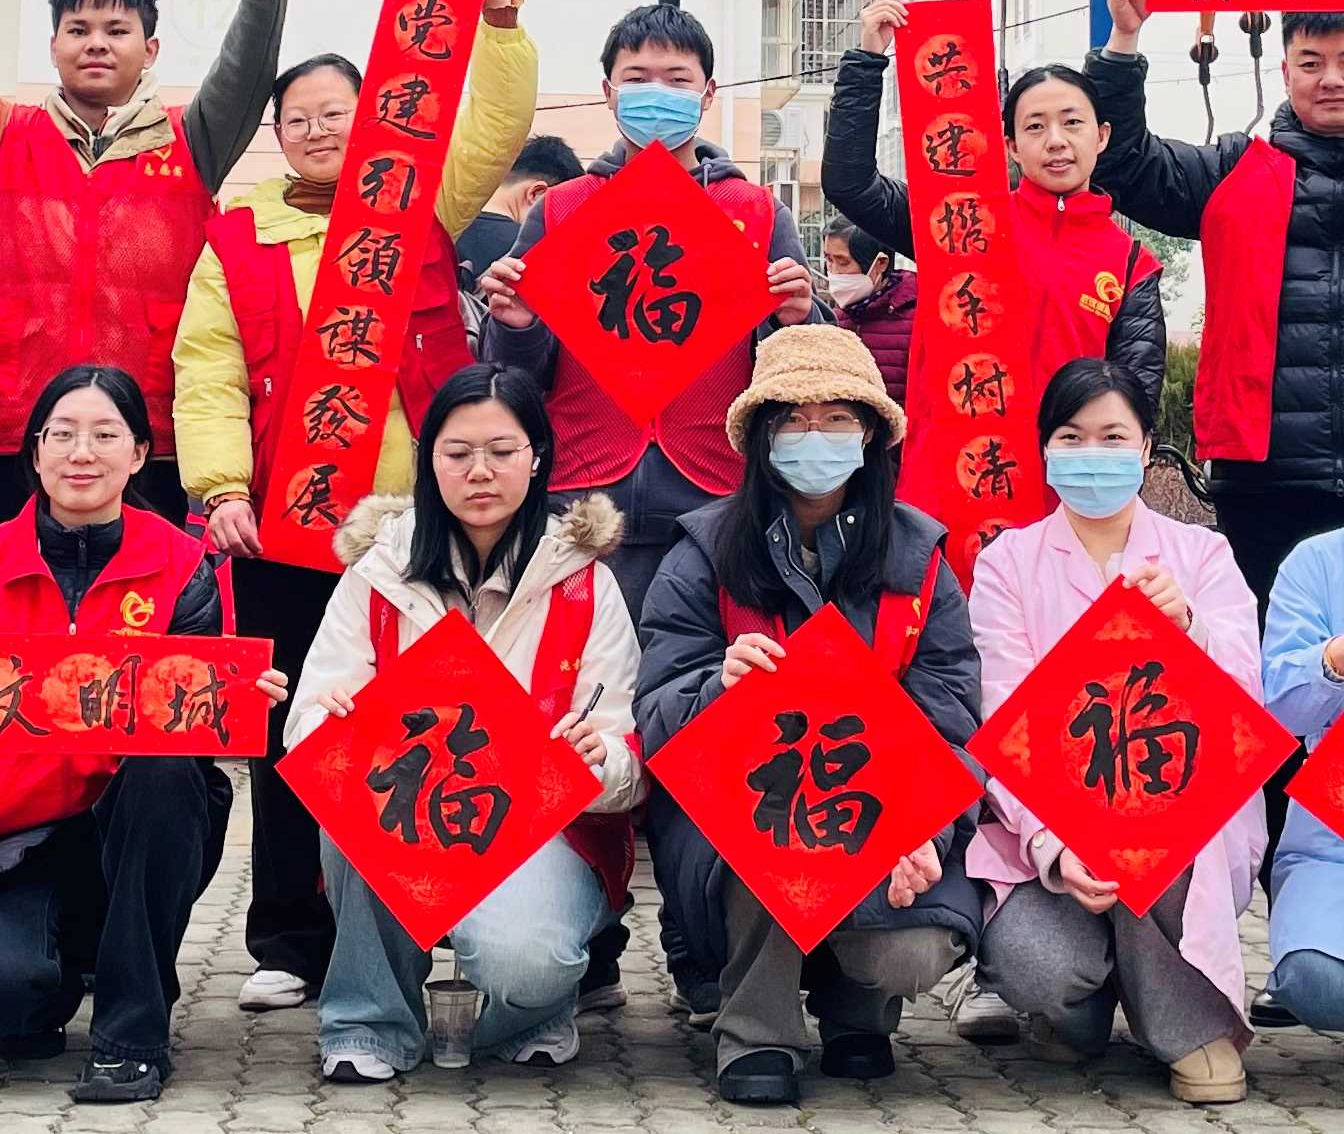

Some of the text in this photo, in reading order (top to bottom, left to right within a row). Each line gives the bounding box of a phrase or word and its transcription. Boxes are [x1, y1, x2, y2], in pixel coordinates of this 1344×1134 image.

[589, 225, 702, 346] 福
[366, 702, 512, 856] 福
[747, 710, 884, 856] 福
[1068, 660, 1201, 807] 福
